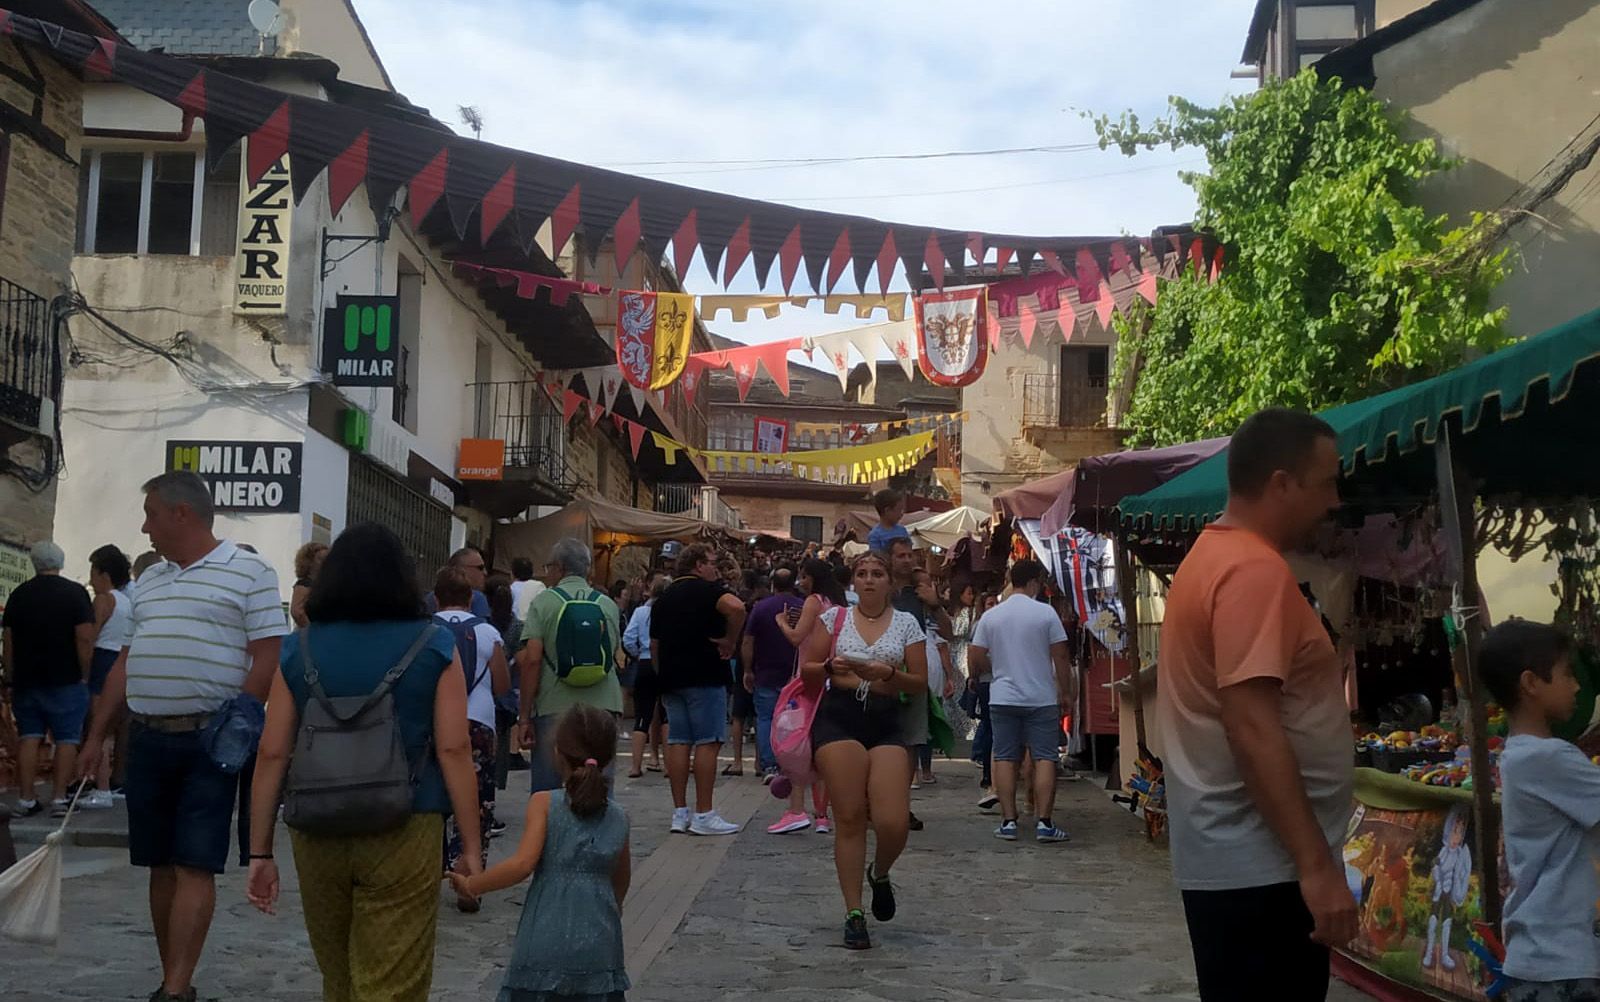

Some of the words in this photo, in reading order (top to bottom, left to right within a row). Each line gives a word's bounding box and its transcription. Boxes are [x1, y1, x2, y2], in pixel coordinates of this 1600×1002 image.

[238, 283, 285, 298] VAQUERO
[337, 358, 394, 377] MILAR
[199, 445, 293, 475] MILAR
[459, 466, 499, 478] orange
[202, 480, 284, 507] NERO
